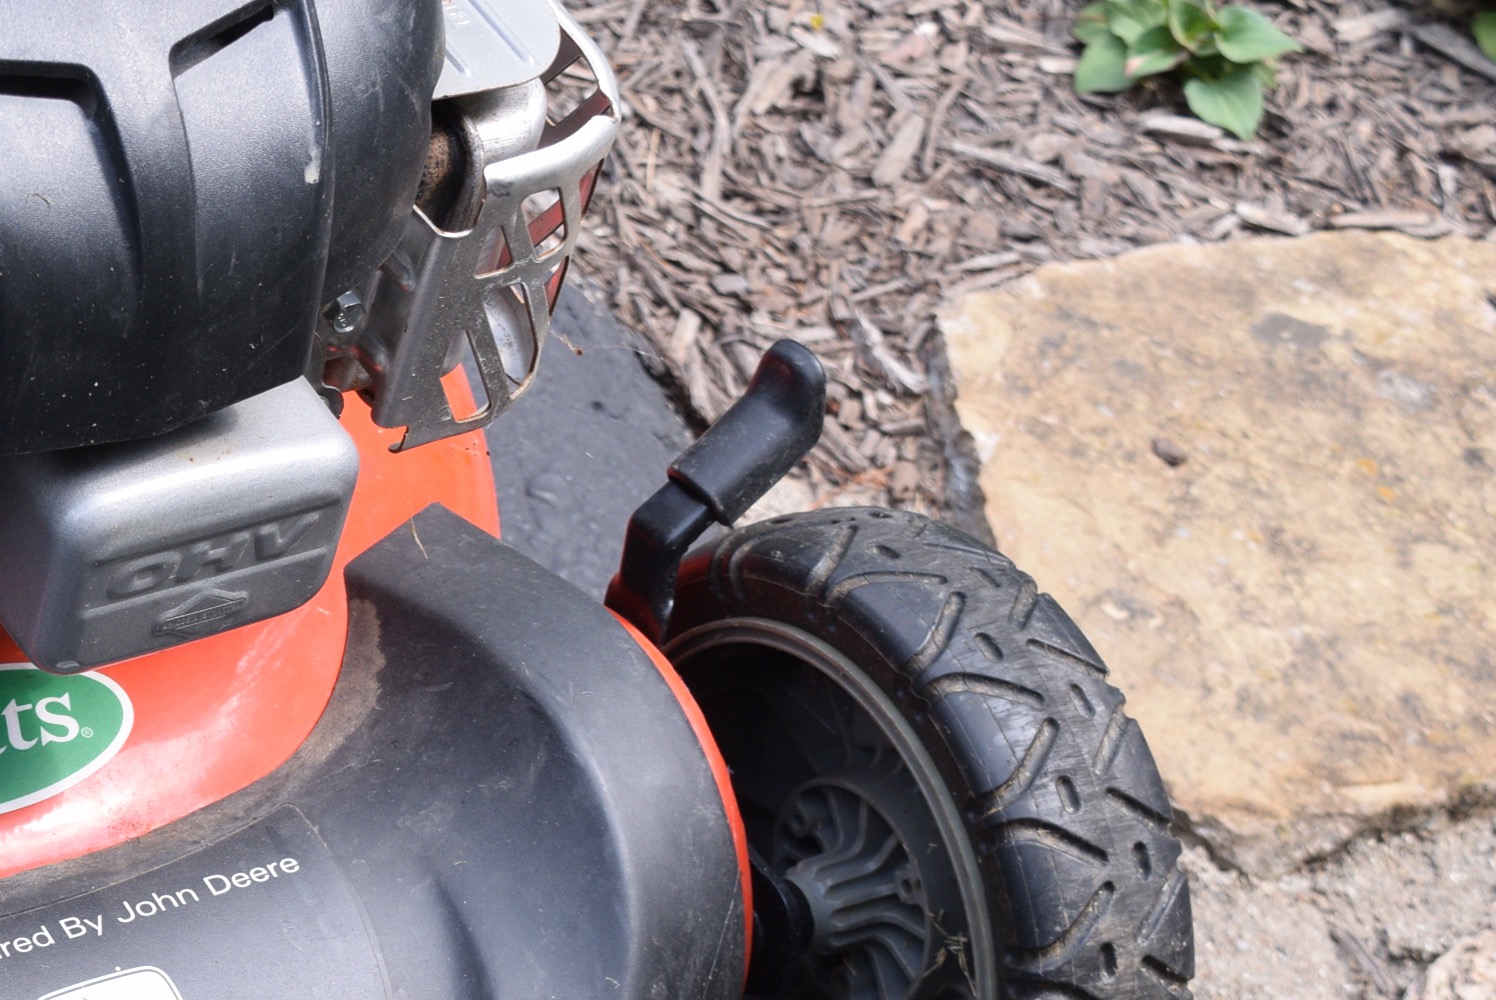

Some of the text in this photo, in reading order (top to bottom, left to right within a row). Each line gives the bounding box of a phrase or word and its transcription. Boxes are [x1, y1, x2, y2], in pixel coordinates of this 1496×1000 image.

[108, 513, 321, 597] OHV
[59, 910, 105, 940] By
[116, 886, 200, 925] John
[202, 857, 301, 897] Deere
